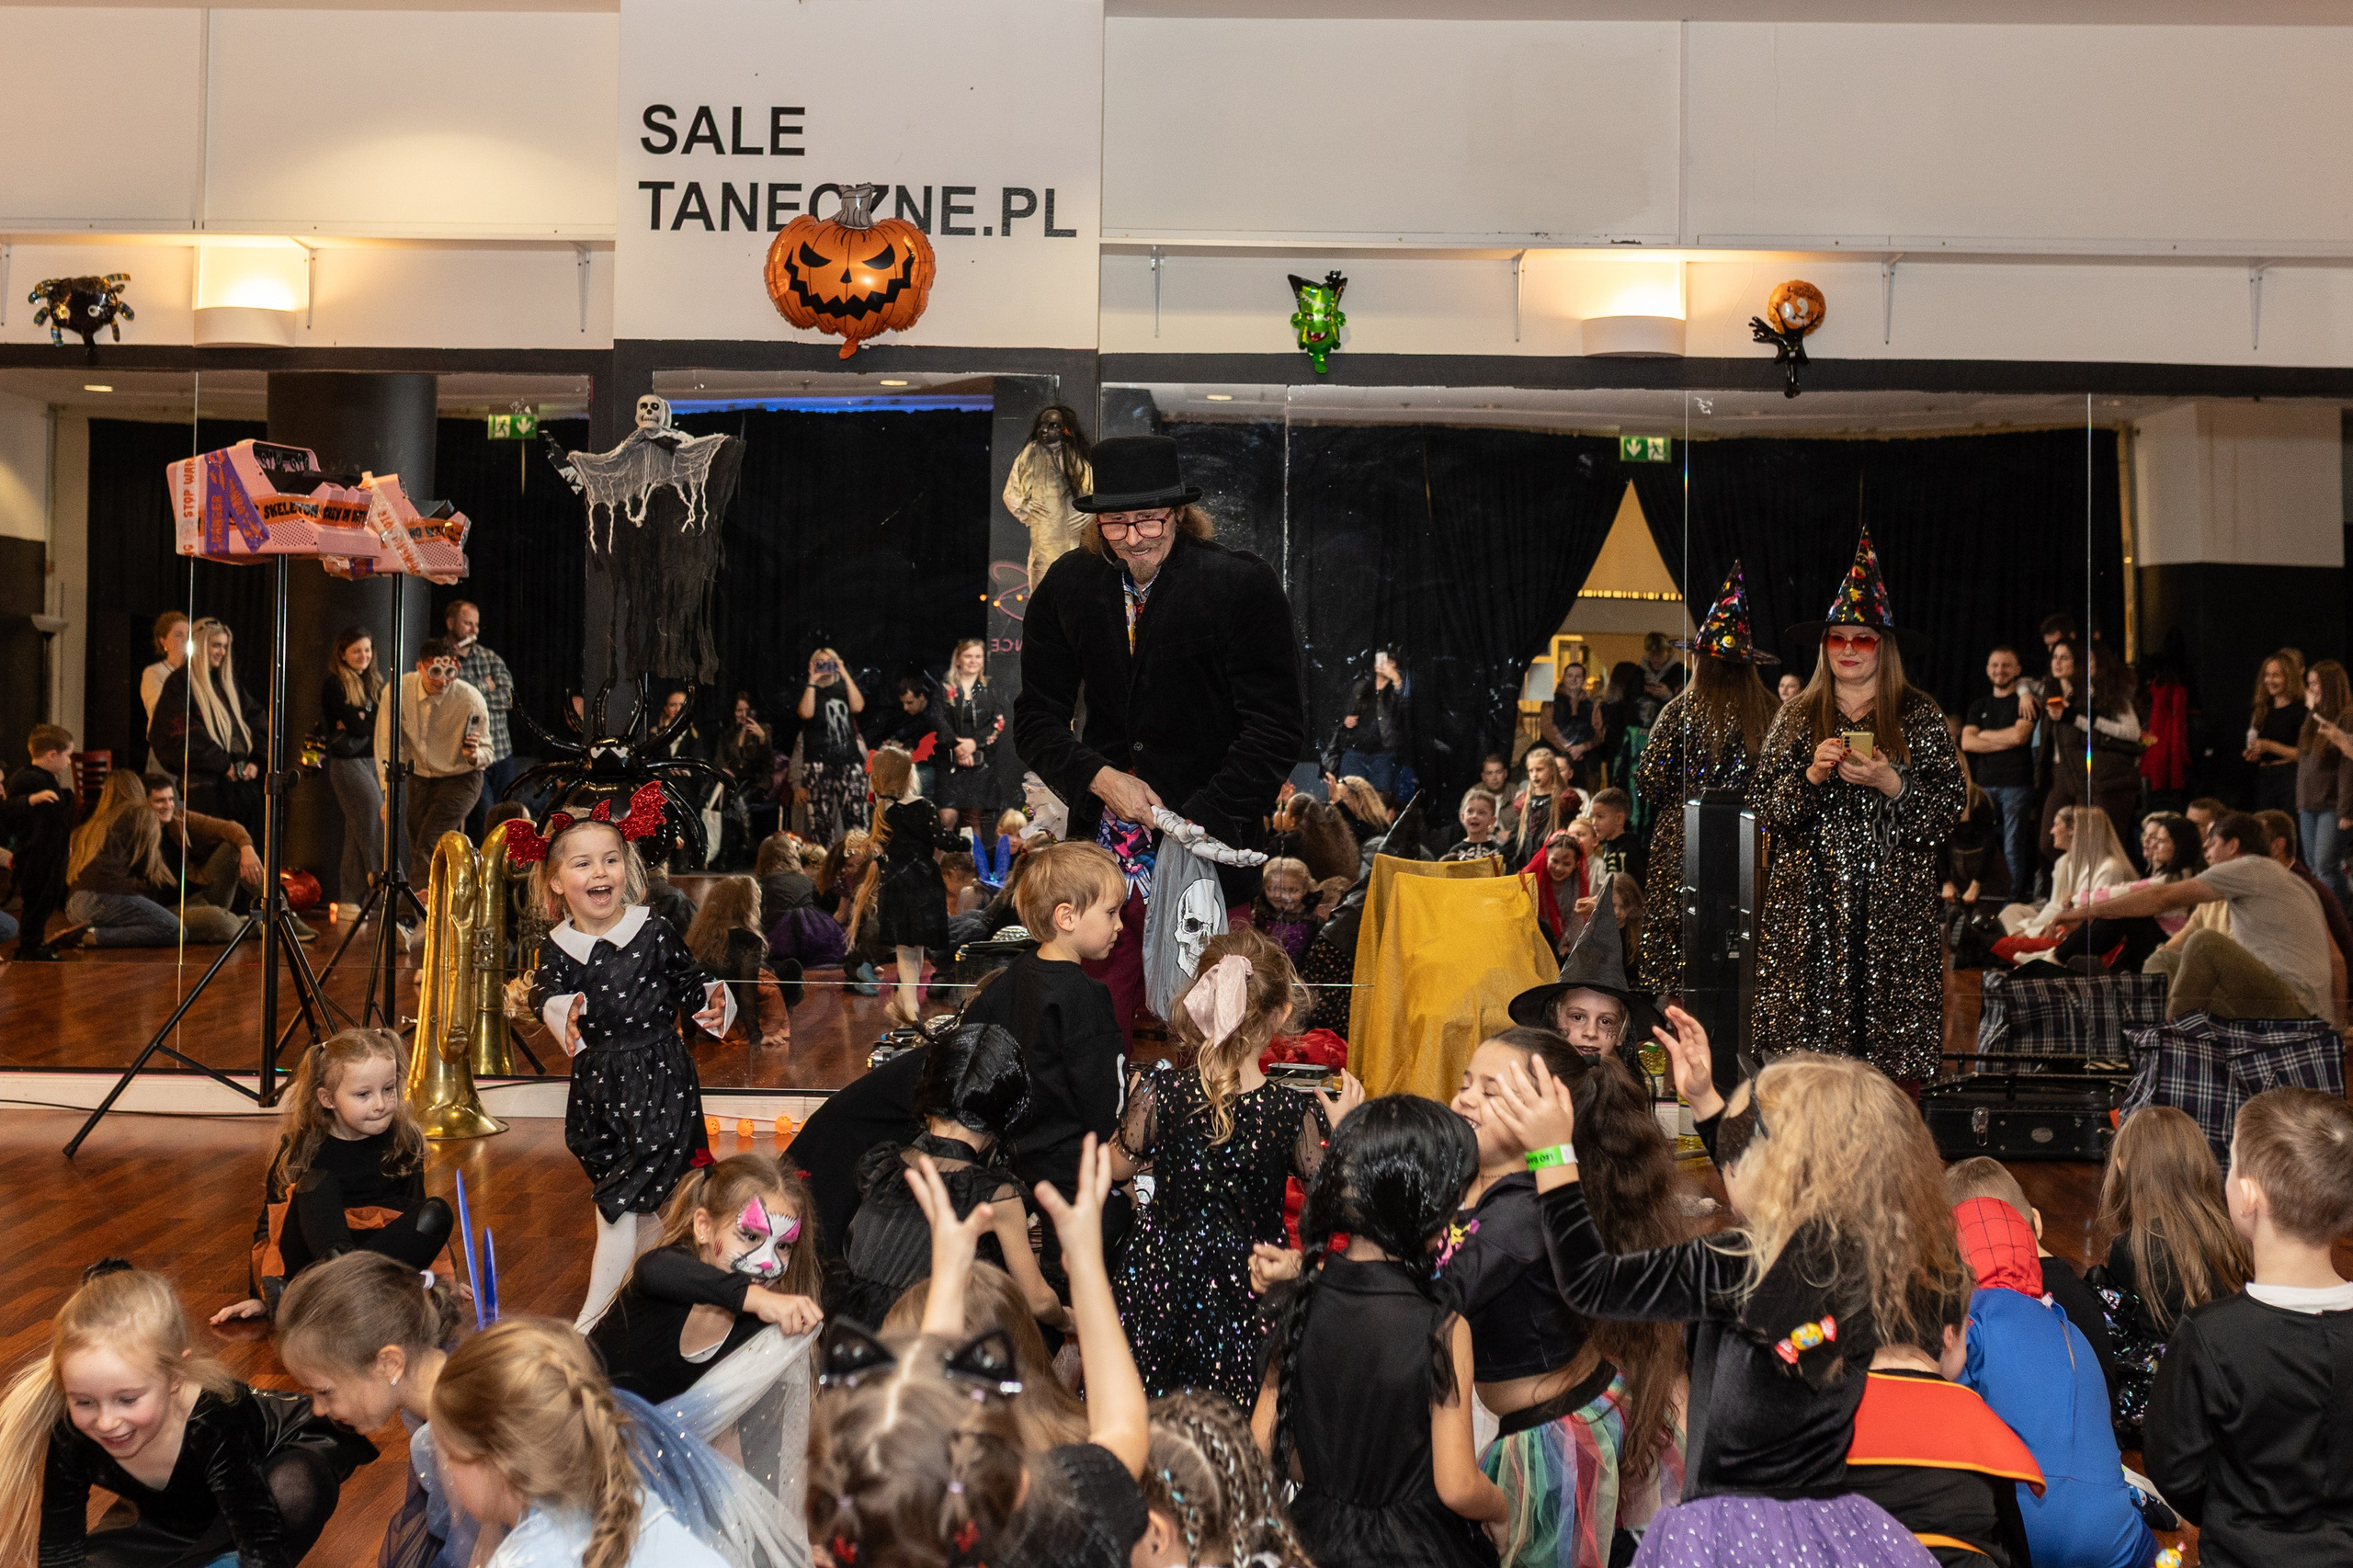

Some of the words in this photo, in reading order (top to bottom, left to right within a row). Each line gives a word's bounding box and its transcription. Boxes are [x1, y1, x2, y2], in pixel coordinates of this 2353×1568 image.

[641, 104, 805, 155] SALE
[183, 489, 194, 517] STOP
[263, 502, 320, 519] SKELETON
